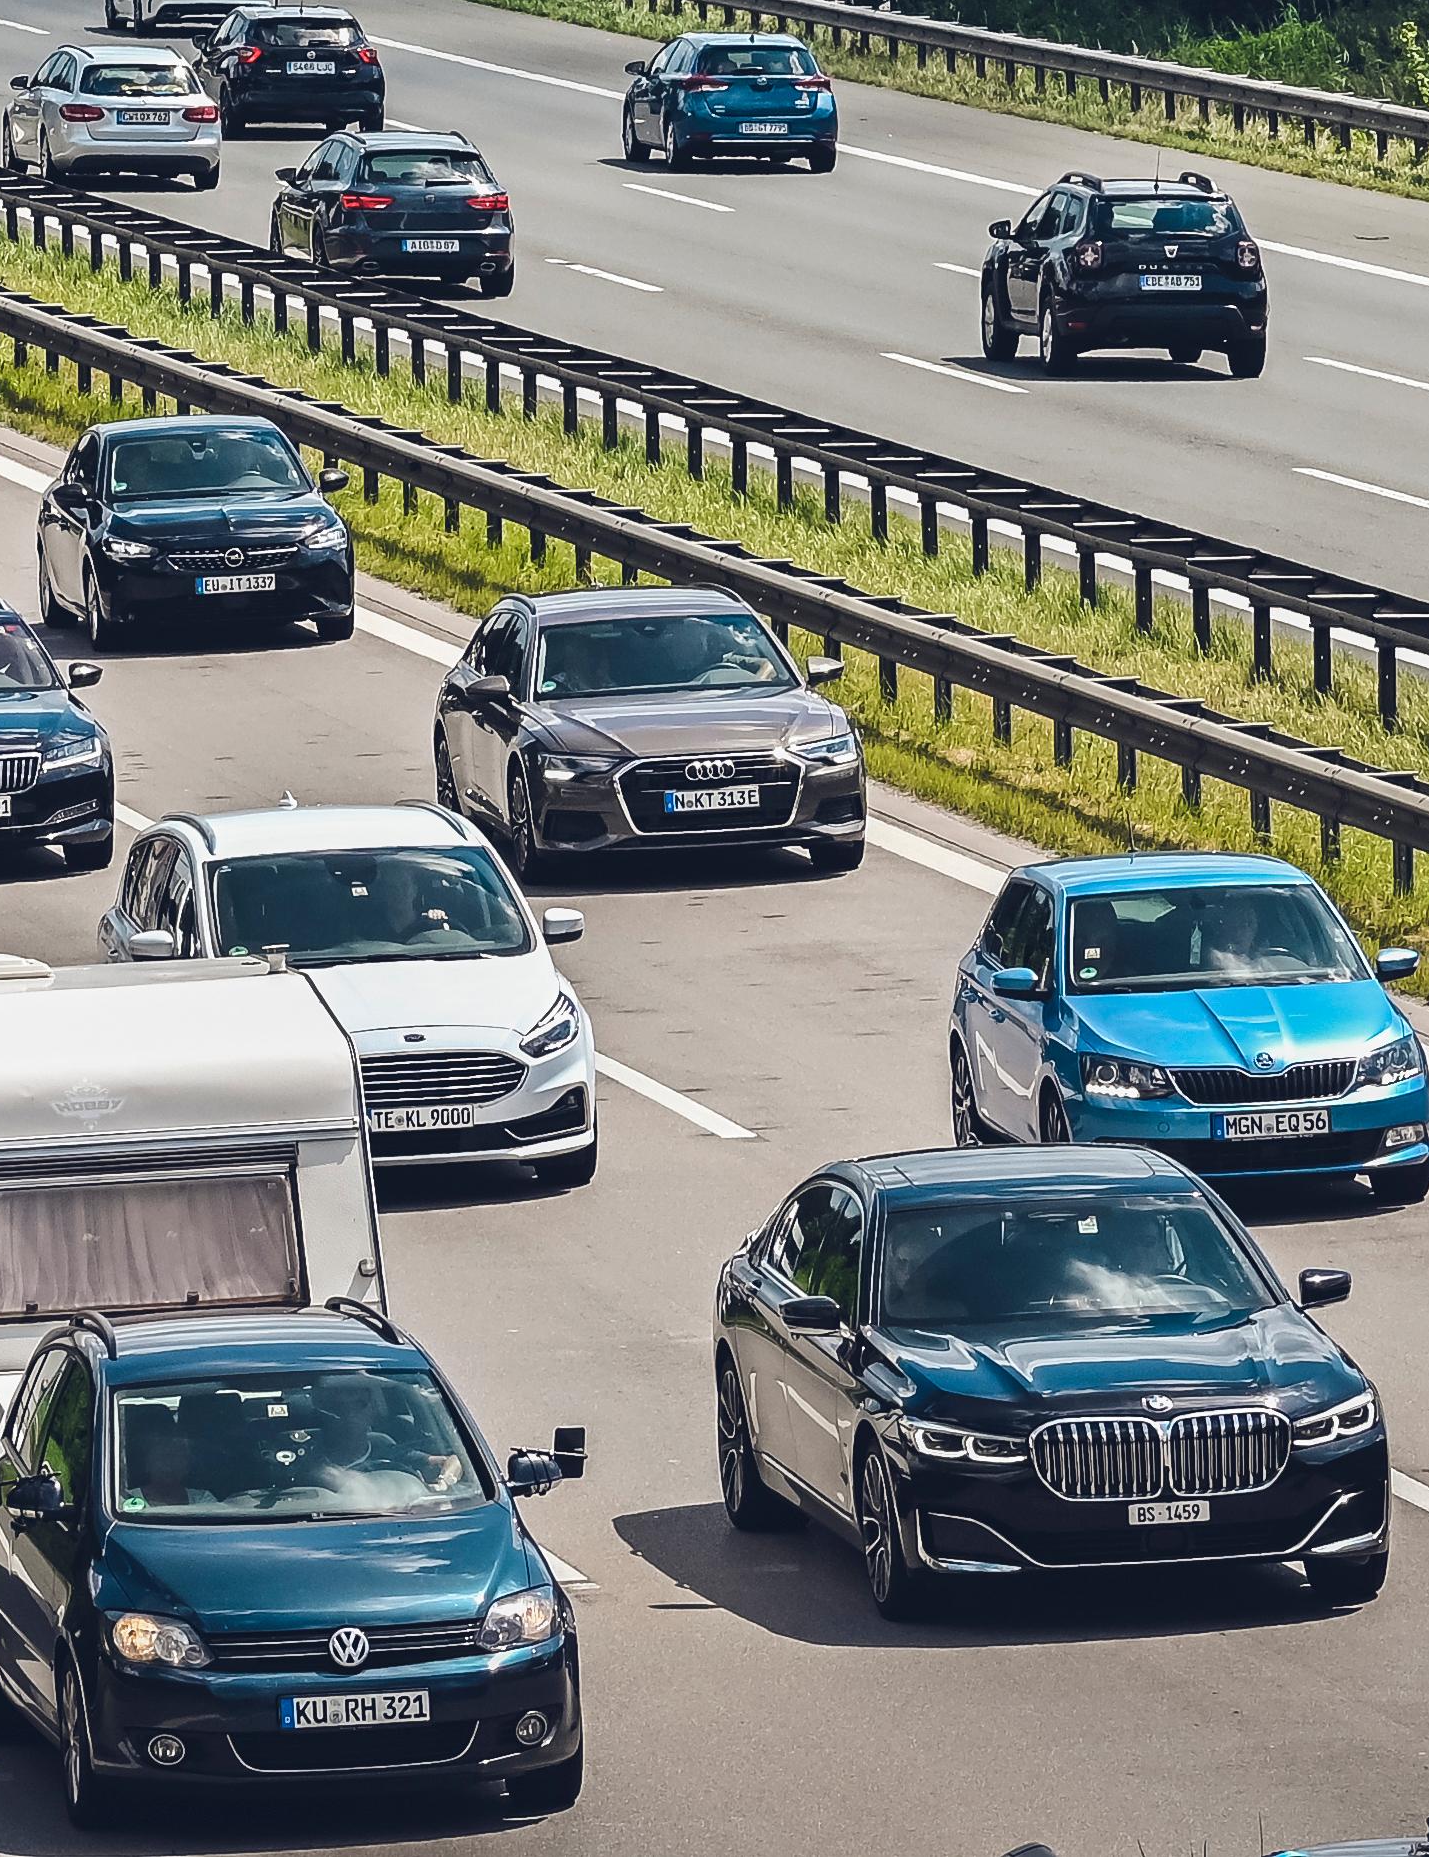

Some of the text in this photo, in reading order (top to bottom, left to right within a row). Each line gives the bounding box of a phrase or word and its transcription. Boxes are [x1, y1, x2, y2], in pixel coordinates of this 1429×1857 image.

[204, 575, 274, 593] EU IT 1337
[675, 788, 759, 807] N KT 313E
[373, 1107, 471, 1128] TE KL 9000
[1225, 1116, 1264, 1136] MGN
[1274, 1114, 1301, 1134] EQ
[1303, 1112, 1327, 1132] 56
[1137, 1503, 1201, 1523] BS 1459
[295, 1699, 328, 1726] KU
[345, 1698, 375, 1724] RH
[382, 1695, 428, 1722] 321
